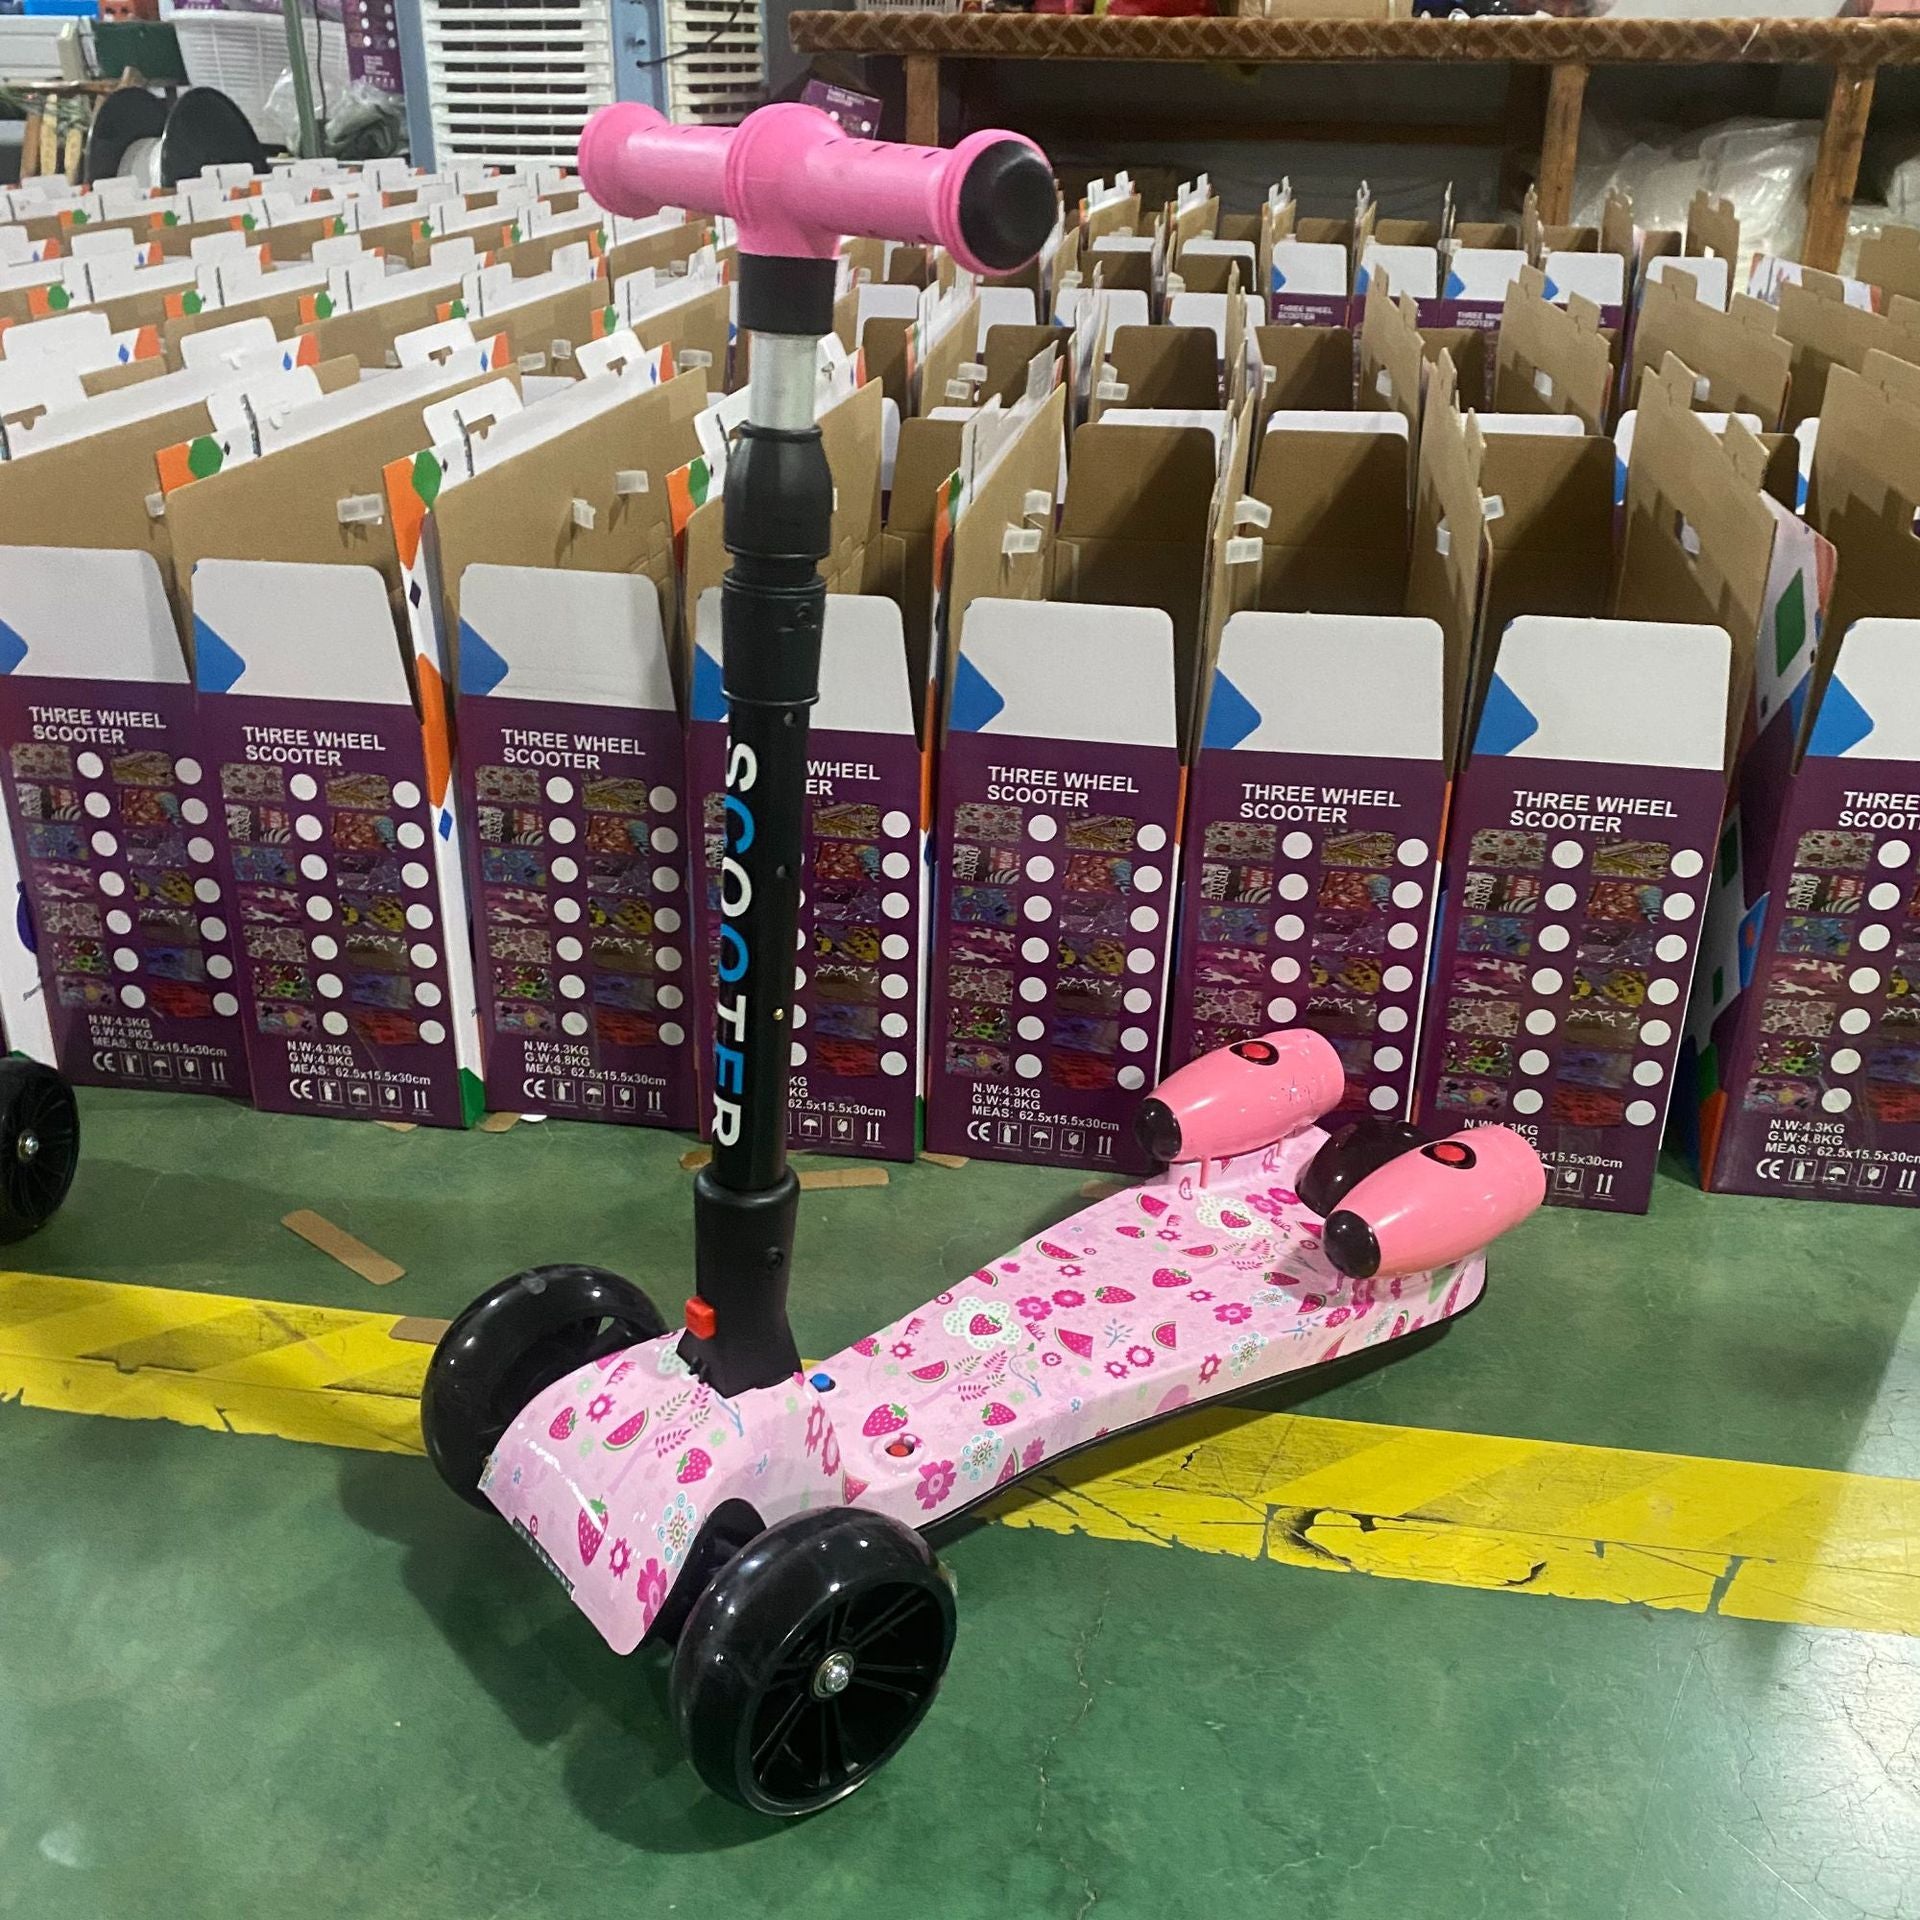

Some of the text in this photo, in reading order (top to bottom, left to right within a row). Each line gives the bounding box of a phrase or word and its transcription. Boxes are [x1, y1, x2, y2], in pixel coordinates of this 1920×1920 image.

[28, 706, 167, 729] THREE WHEEL
[32, 724, 126, 745] SCOOTER
[242, 725, 386, 751] THREE WHEEL
[501, 728, 646, 756] THREE WHEEL
[245, 745, 343, 767] SCOOTER
[503, 747, 601, 770] SCOOTER
[806, 760, 882, 781] WHEEL
[987, 765, 1140, 793] THREE WHEEL
[987, 784, 1089, 808] SCOOTER
[1241, 783, 1402, 808] THREE WHEEL
[1512, 790, 1679, 818] THREE WHEEL
[1843, 791, 1920, 811] THREE
[1239, 802, 1348, 824] SCOOTER
[1509, 809, 1622, 833] SCOOTER
[1838, 810, 1920, 831] SCOOT
[711, 735, 758, 1147] SCOOTER
[525, 1063, 567, 1076] MEAS:
[971, 1105, 1014, 1119] MEAS:
[1764, 1142, 1812, 1156] MEAS:
